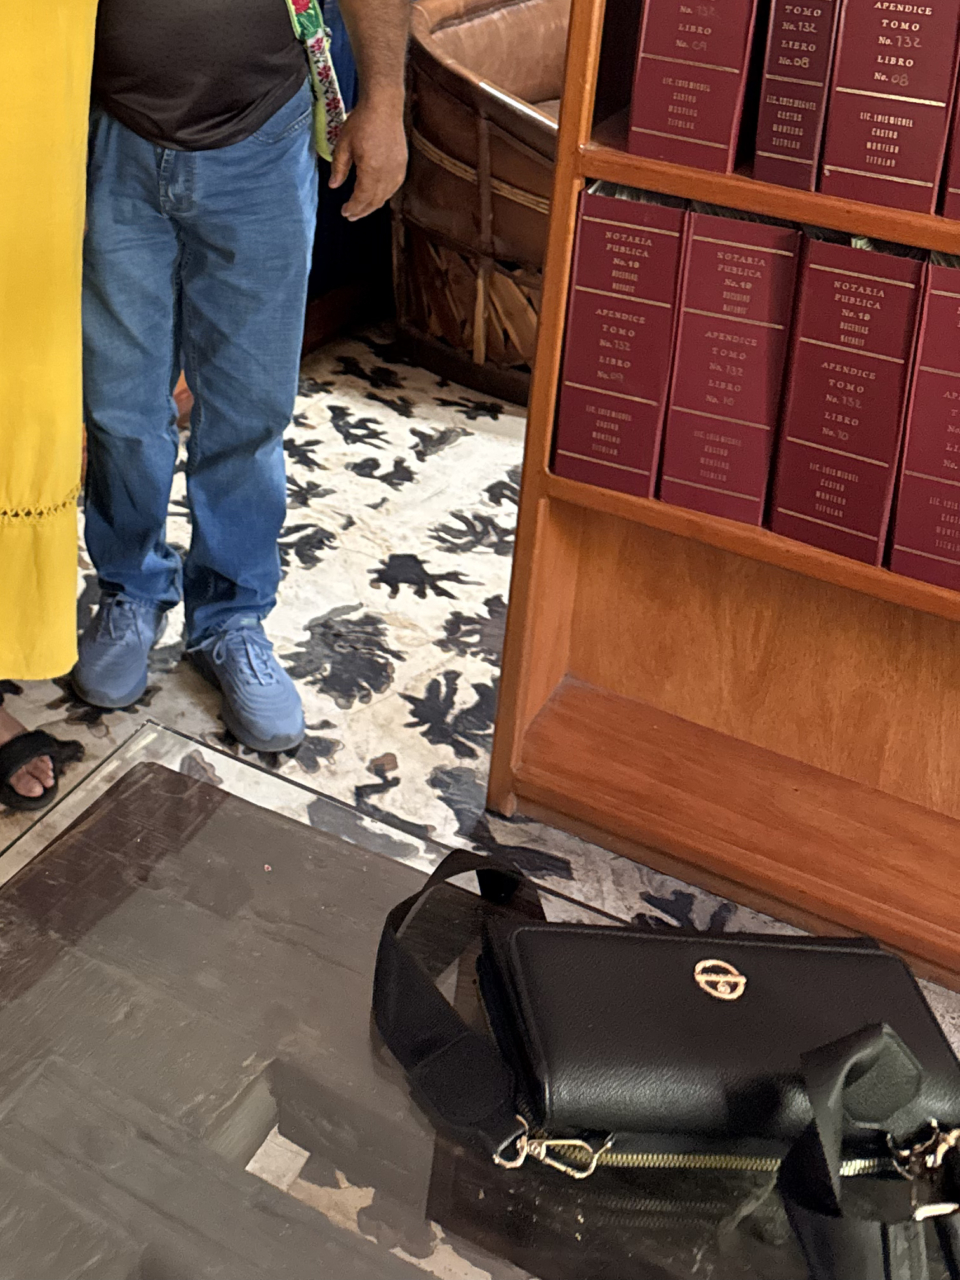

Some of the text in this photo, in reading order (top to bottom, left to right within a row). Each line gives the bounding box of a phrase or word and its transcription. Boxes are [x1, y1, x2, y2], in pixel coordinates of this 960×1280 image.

[785, 5, 822, 16] TOMO
[874, 1, 932, 15] APENDICE
[678, 24, 711, 35] LIBRO
[882, 19, 919, 31] TOMO
[781, 40, 816, 51] LIBRO
[878, 36, 893, 45] No.
[794, 57, 810, 68] 08
[877, 55, 914, 67] LIBRO
[874, 72, 888, 81] No.
[605, 231, 652, 246] NOTARIA
[606, 244, 649, 258] PUBLICA
[717, 251, 766, 266] NOTARIA
[834, 281, 885, 297] NOTARIA
[834, 294, 881, 309] PUBLICA
[595, 309, 645, 324] APENDICE
[602, 325, 635, 337] TOMO
[705, 330, 758, 346] APENDICE
[712, 347, 746, 359] TOMO
[599, 356, 631, 368] LIBRO
[822, 362, 876, 380] APENDICE
[708, 379, 741, 392] LIBRO
[828, 379, 864, 393] TOMO
[824, 412, 859, 426] LIBRO
